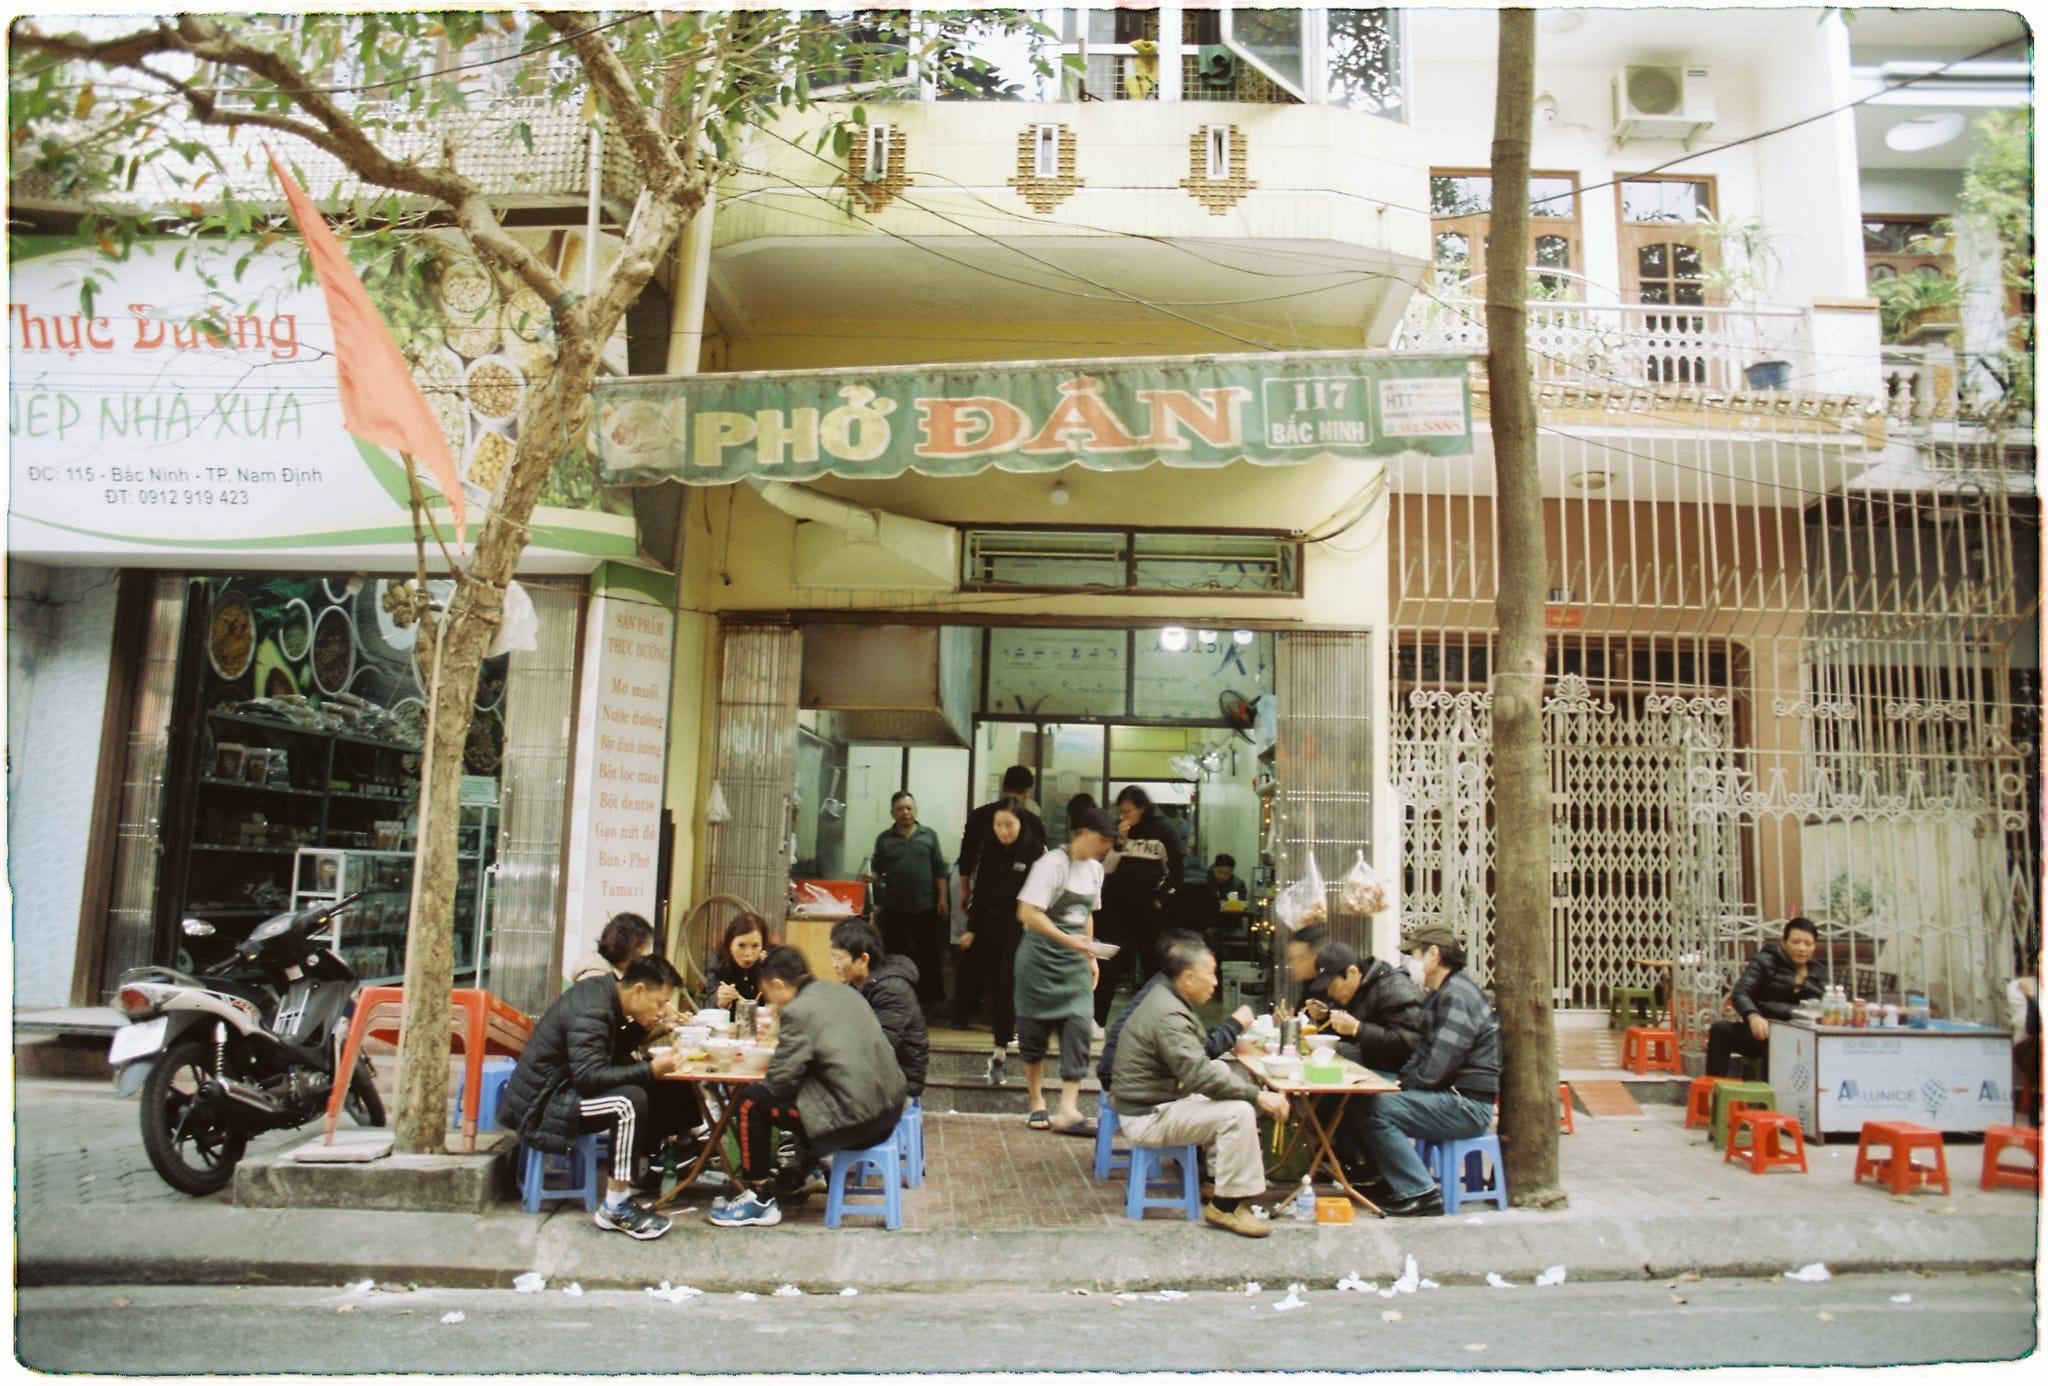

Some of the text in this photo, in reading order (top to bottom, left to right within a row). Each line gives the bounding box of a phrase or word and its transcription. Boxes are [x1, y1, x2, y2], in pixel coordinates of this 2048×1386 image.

[1293, 382, 1348, 411] 117
[99, 380, 192, 441] NHÀ
[214, 385, 302, 440] XƯA
[693, 385, 898, 467] PHỞ
[1318, 421, 1365, 442] NINH
[28, 466, 56, 482] ĐC:
[66, 467, 95, 482] 115
[149, 466, 190, 483] Ninh
[206, 467, 231, 483] TP.
[237, 467, 276, 483] Nam
[282, 467, 323, 487] Định
[105, 489, 250, 505] ĐT: 0912 919 423
[600, 879, 644, 897] Tamari
